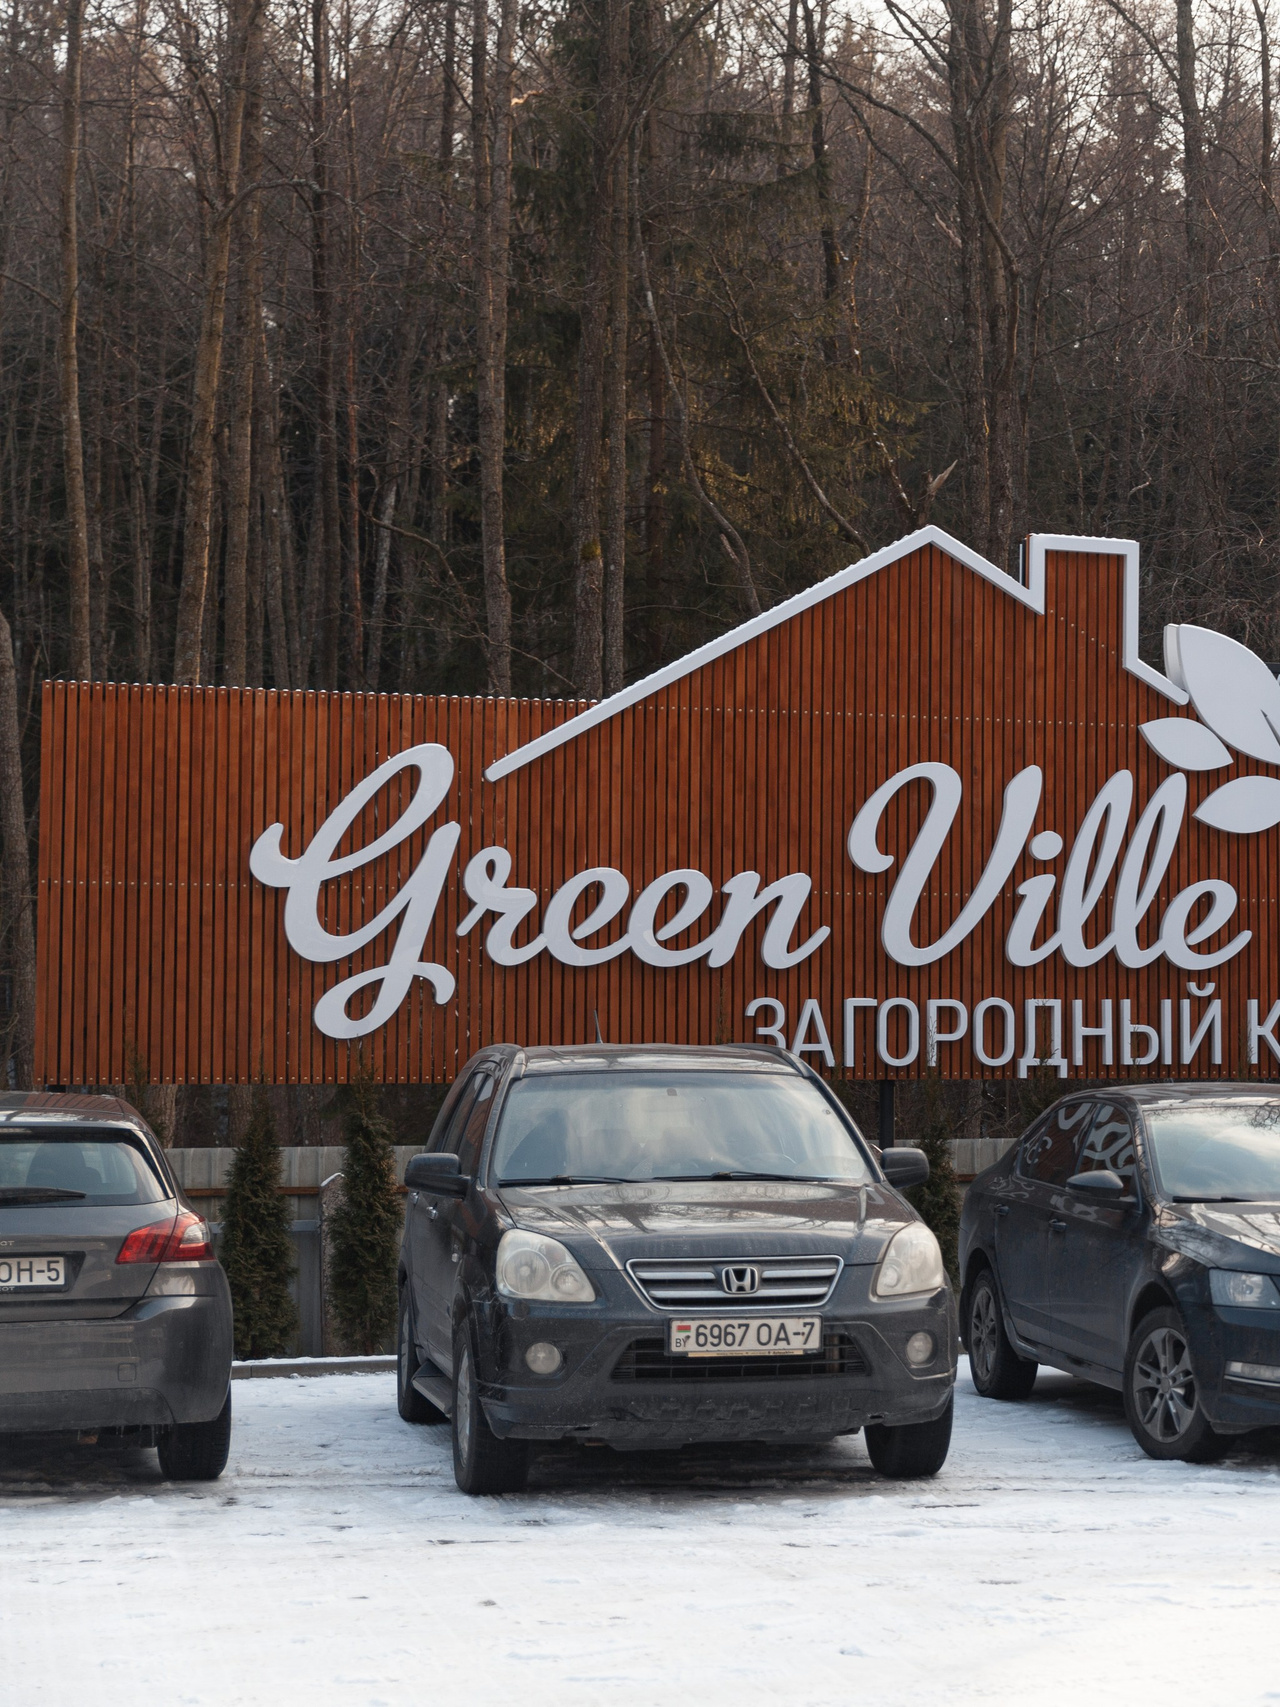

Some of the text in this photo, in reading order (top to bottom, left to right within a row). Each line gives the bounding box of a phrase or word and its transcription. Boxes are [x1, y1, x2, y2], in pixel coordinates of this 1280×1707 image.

[249, 742, 1253, 1039] Green Ville
[745, 982, 1222, 1079] ЗАГОРОДНЫЙ
[675, 1337, 688, 1348] BY
[695, 1321, 815, 1347] 6967 OA-7
